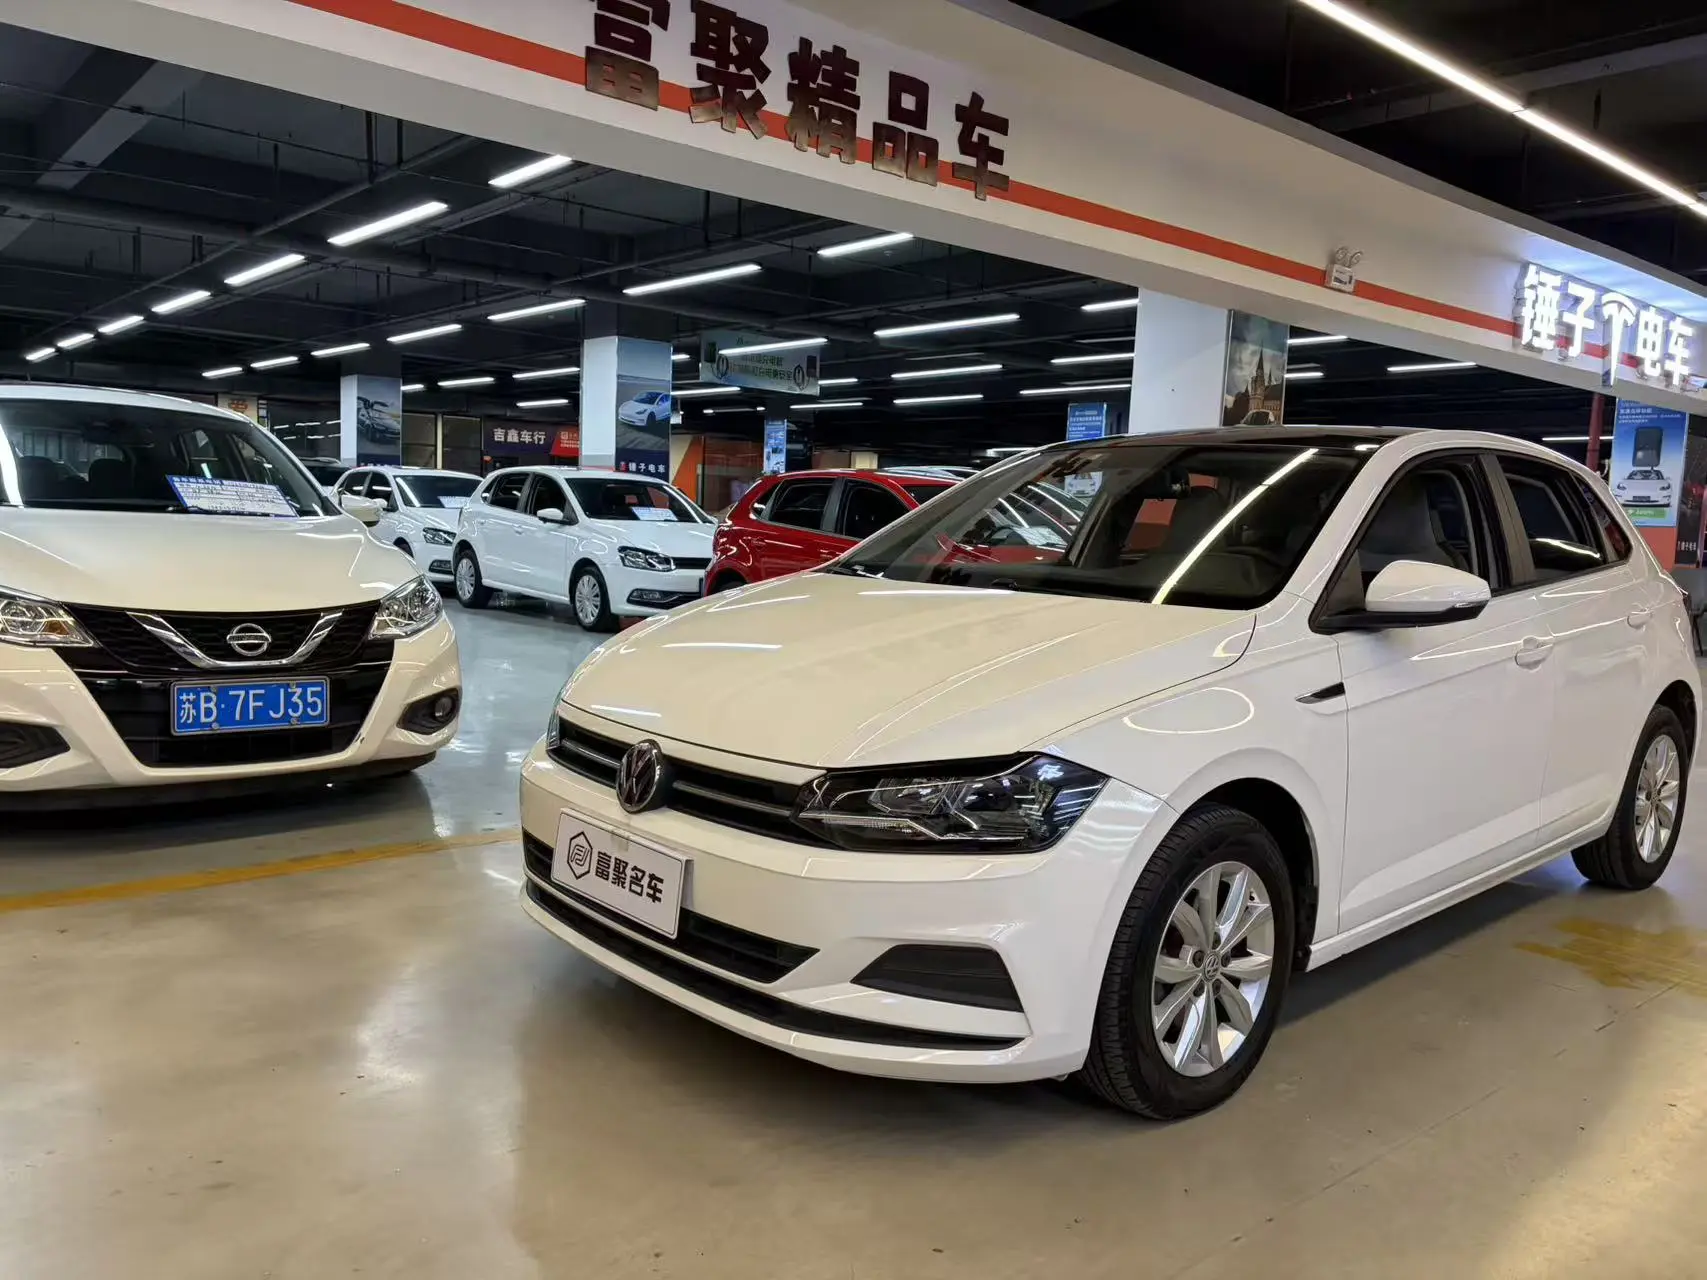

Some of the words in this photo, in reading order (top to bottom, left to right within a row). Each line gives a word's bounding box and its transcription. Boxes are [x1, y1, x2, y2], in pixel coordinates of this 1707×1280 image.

[585, 0, 1010, 201] 富聚精品车
[493, 428, 546, 445] 吉鑫车行
[595, 850, 665, 904] 富聚名车
